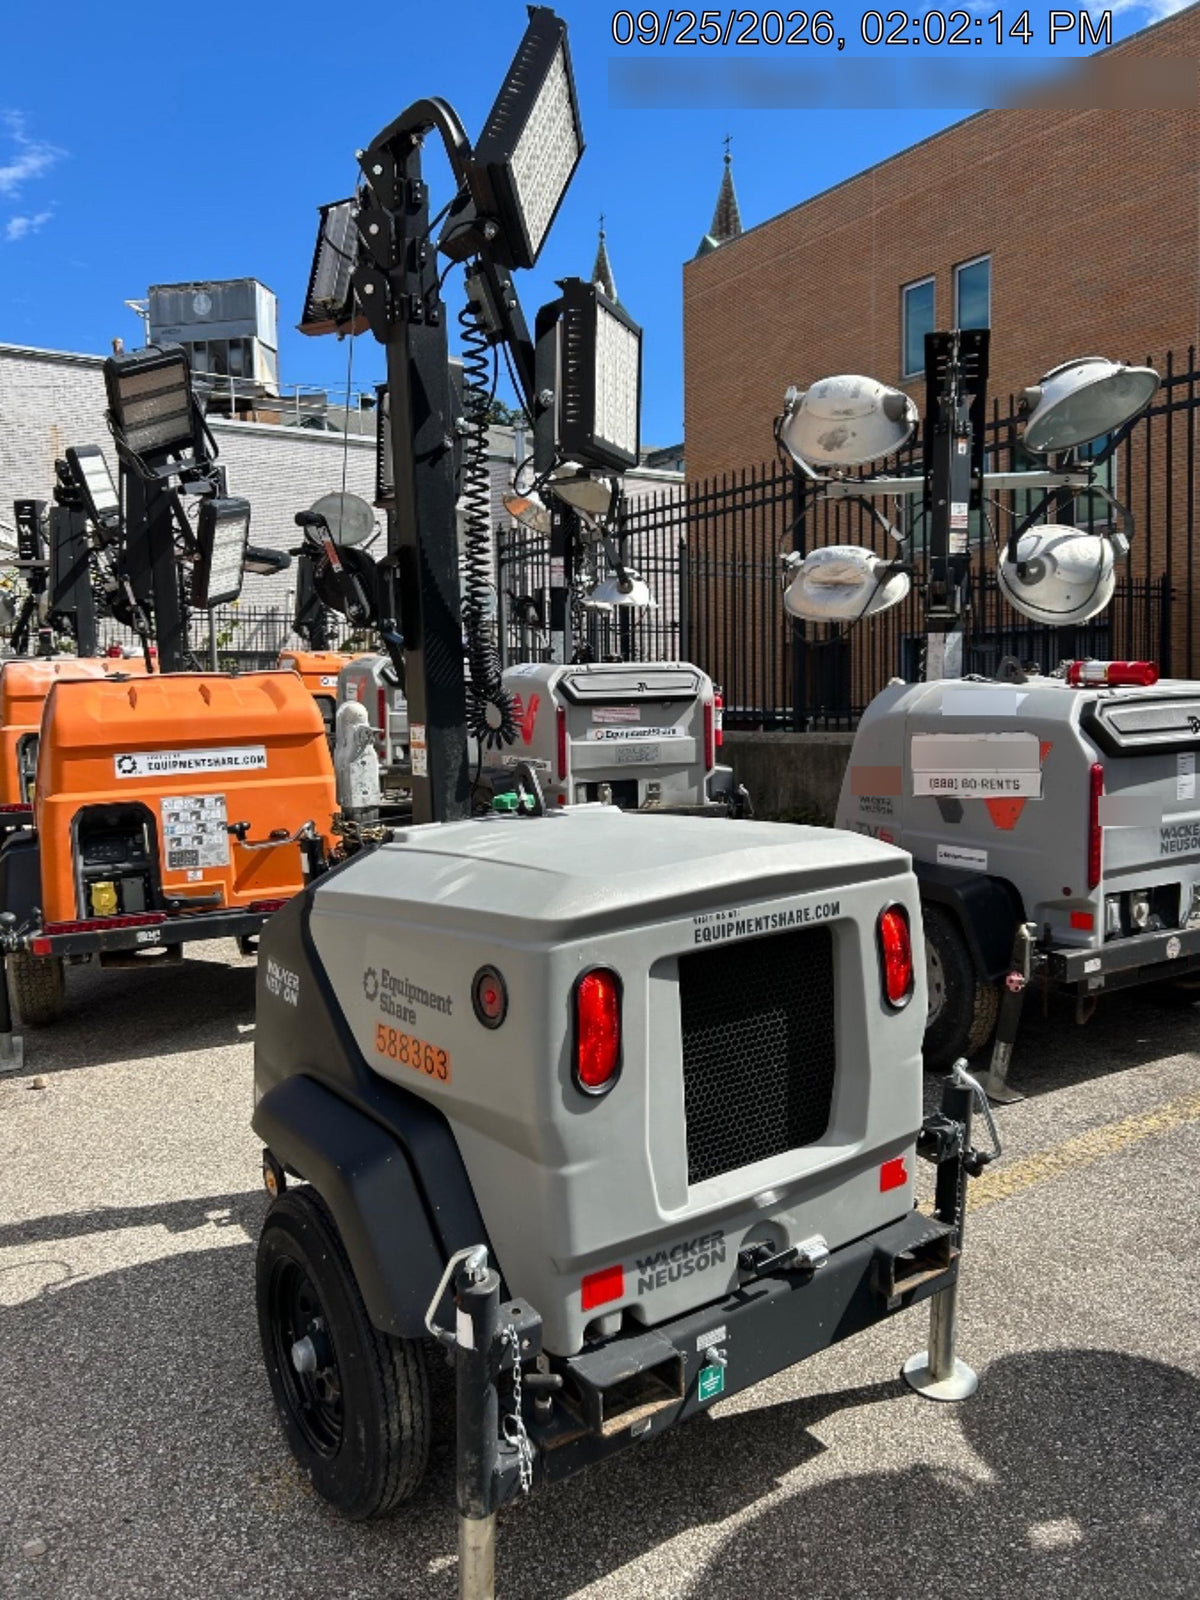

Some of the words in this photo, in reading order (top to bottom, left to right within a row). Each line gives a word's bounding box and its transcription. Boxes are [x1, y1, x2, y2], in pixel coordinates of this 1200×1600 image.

[147, 754, 265, 771] EQUIPMENTSHARE.COM
[1160, 824, 1200, 841] WACKE
[1160, 836, 1200, 855] NEUSO
[694, 901, 841, 944] EQUIPMENTSHARE.COM
[266, 973, 300, 1008] NEUON
[379, 991, 417, 1025] Share
[380, 968, 453, 1016] Equipment
[375, 1023, 451, 1082] 588363
[636, 1229, 726, 1275] WACKER
[637, 1246, 726, 1296] NEUSON
